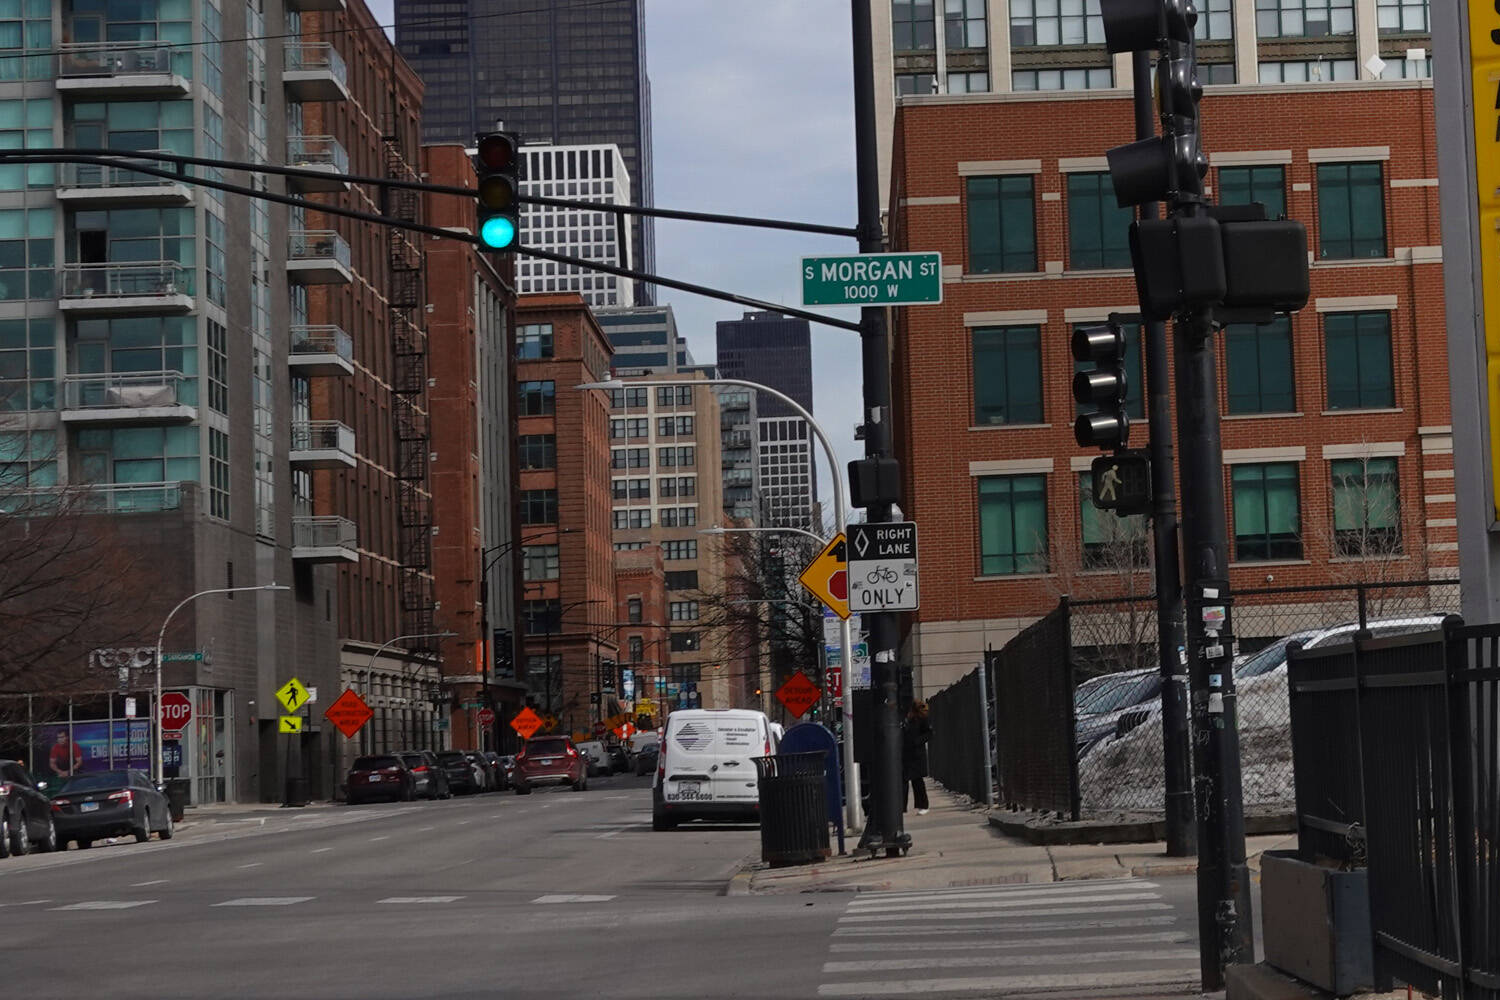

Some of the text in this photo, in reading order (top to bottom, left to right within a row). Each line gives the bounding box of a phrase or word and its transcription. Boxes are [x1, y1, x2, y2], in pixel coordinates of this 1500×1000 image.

[805, 260, 937, 282] S MORGAN ST
[843, 284, 899, 299] 1000 W
[876, 528, 912, 540] RIGHT
[879, 543, 911, 555] LANE
[861, 587, 905, 605] ONLY
[160, 704, 190, 719] STOP
[91, 742, 149, 758] ENGNEERING
